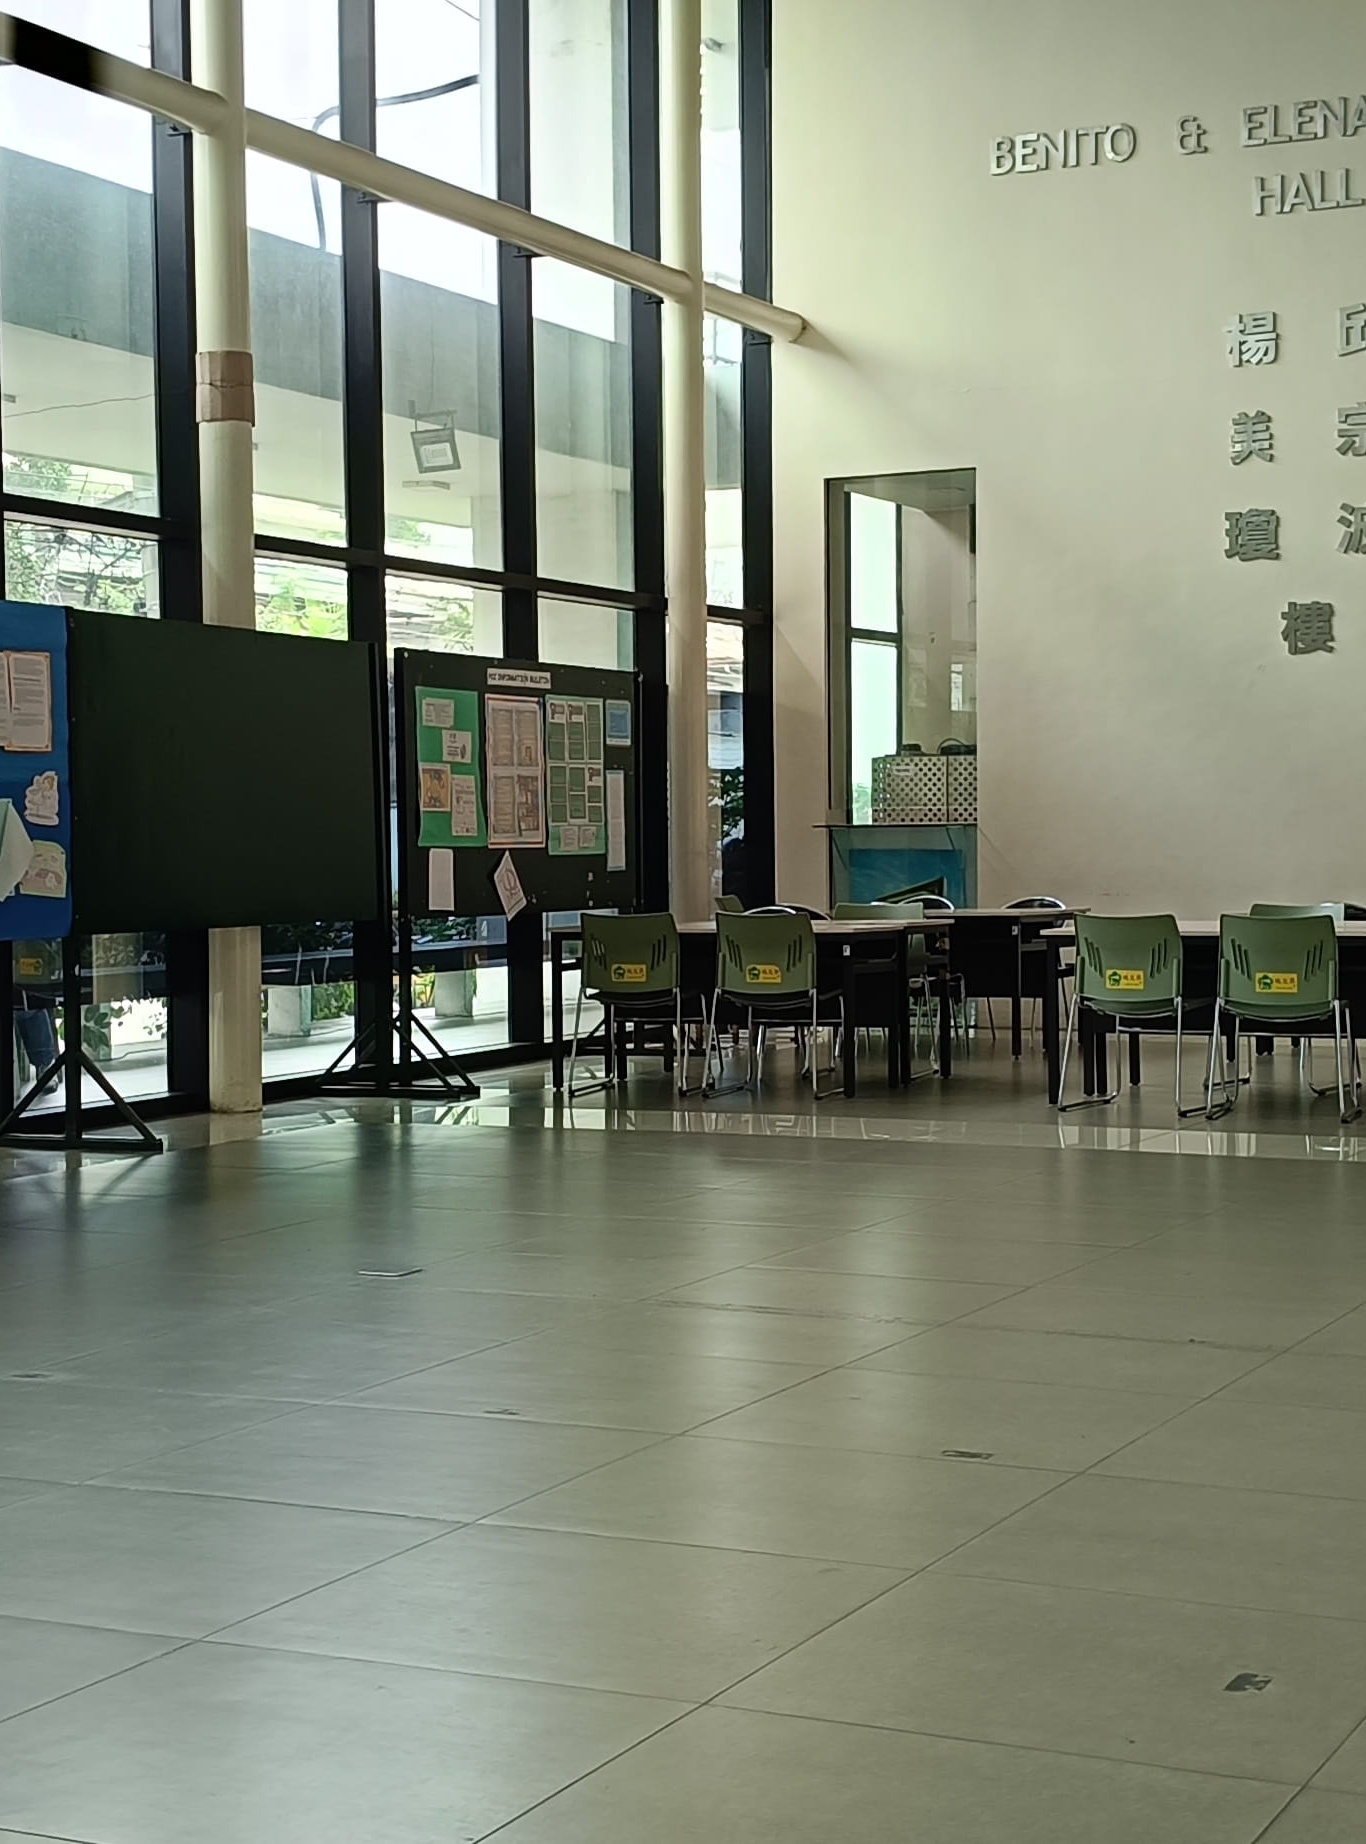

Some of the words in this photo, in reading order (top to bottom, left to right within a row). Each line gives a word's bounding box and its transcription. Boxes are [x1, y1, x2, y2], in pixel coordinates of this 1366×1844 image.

[991, 123, 1137, 175] BENITO
[1177, 115, 1208, 155] &
[1254, 169, 1365, 216] HALL
